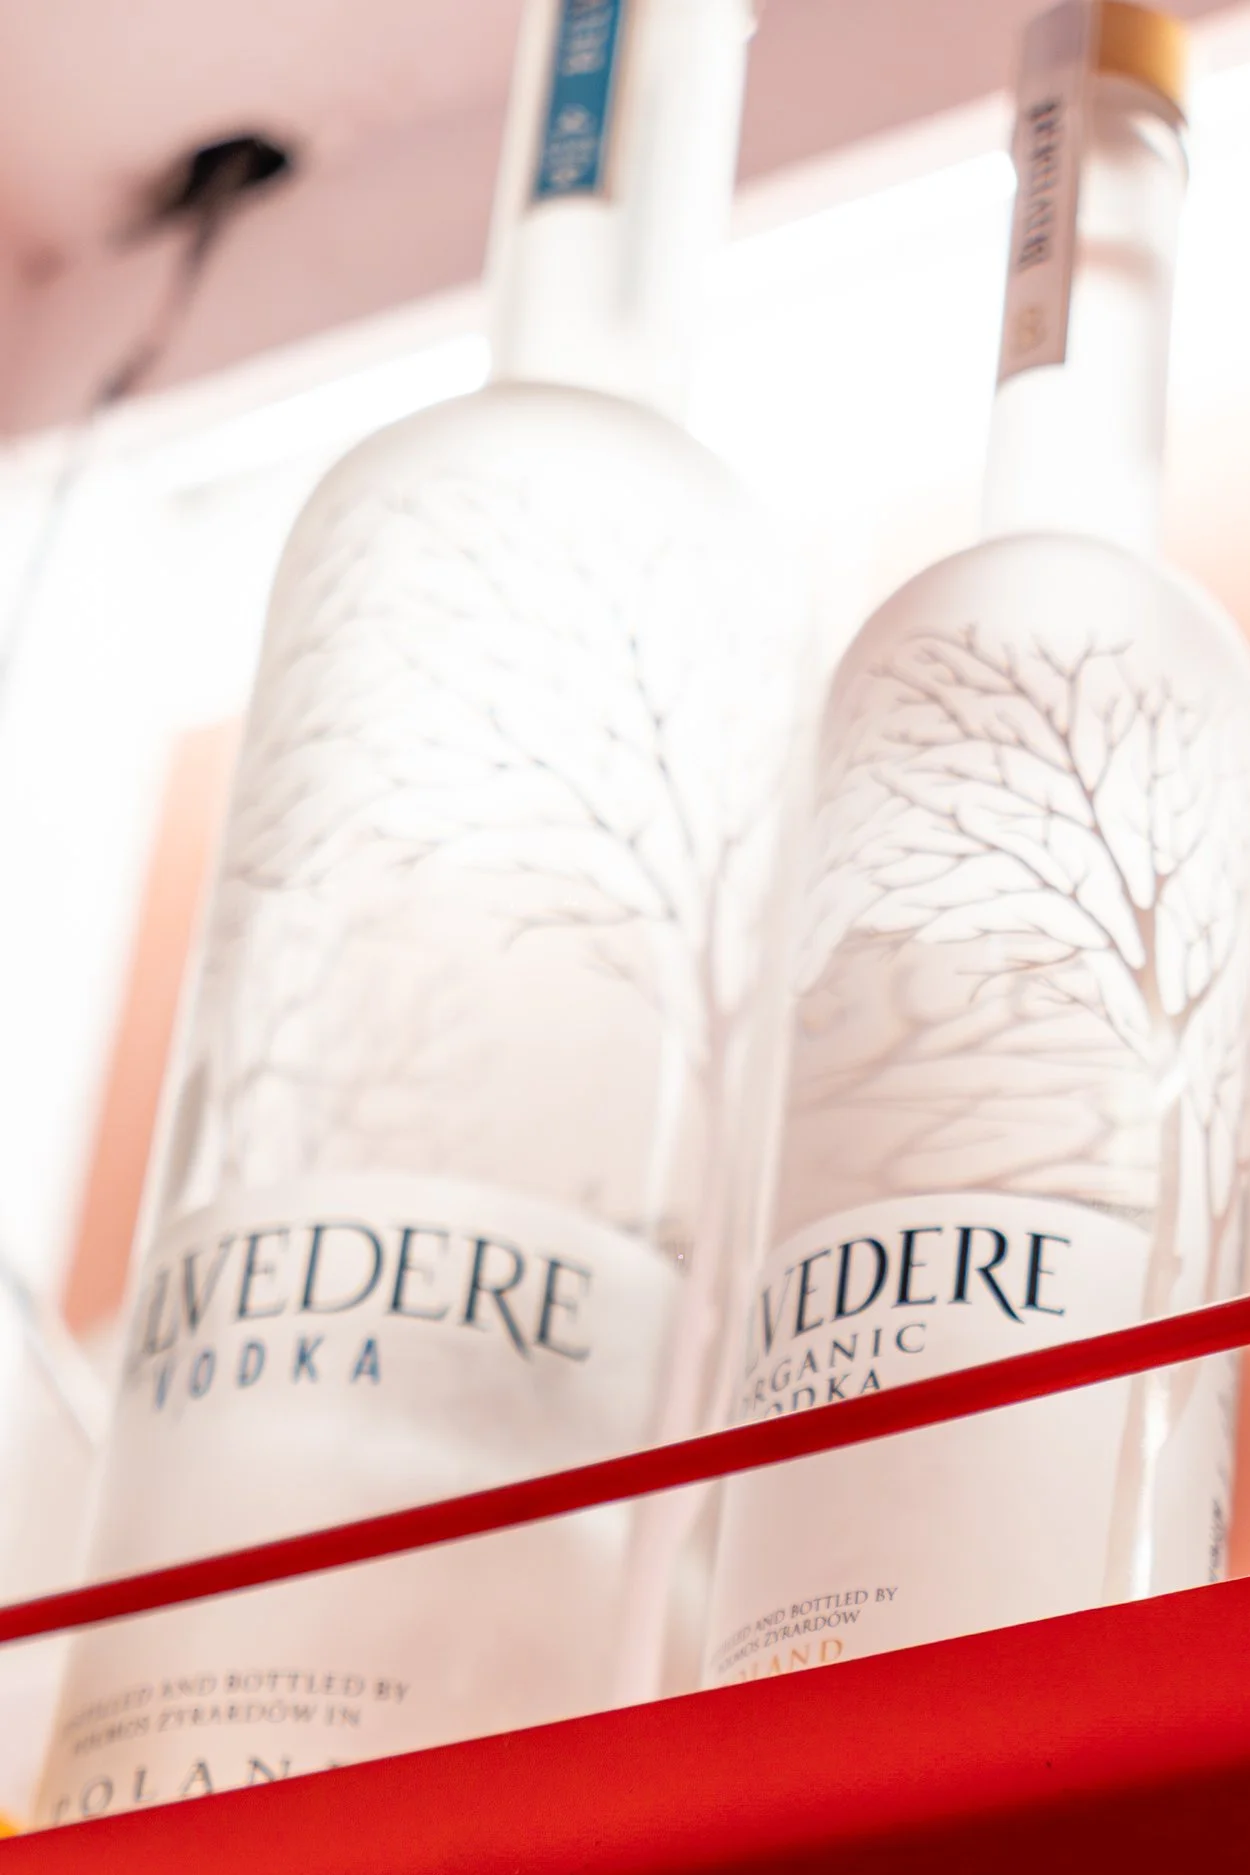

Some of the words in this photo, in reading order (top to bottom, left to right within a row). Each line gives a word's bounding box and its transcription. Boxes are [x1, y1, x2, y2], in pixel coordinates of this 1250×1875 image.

[746, 1225, 1072, 1373] VEDERE
[152, 1334, 382, 1411] VODKA
[755, 1610, 786, 1632] AND
[790, 1590, 869, 1618] BOTTLED
[874, 1586, 899, 1603] BY
[223, 1669, 365, 1699] BOTTLED
[374, 1678, 411, 1703] BY
[53, 1756, 350, 1826] POLAN
